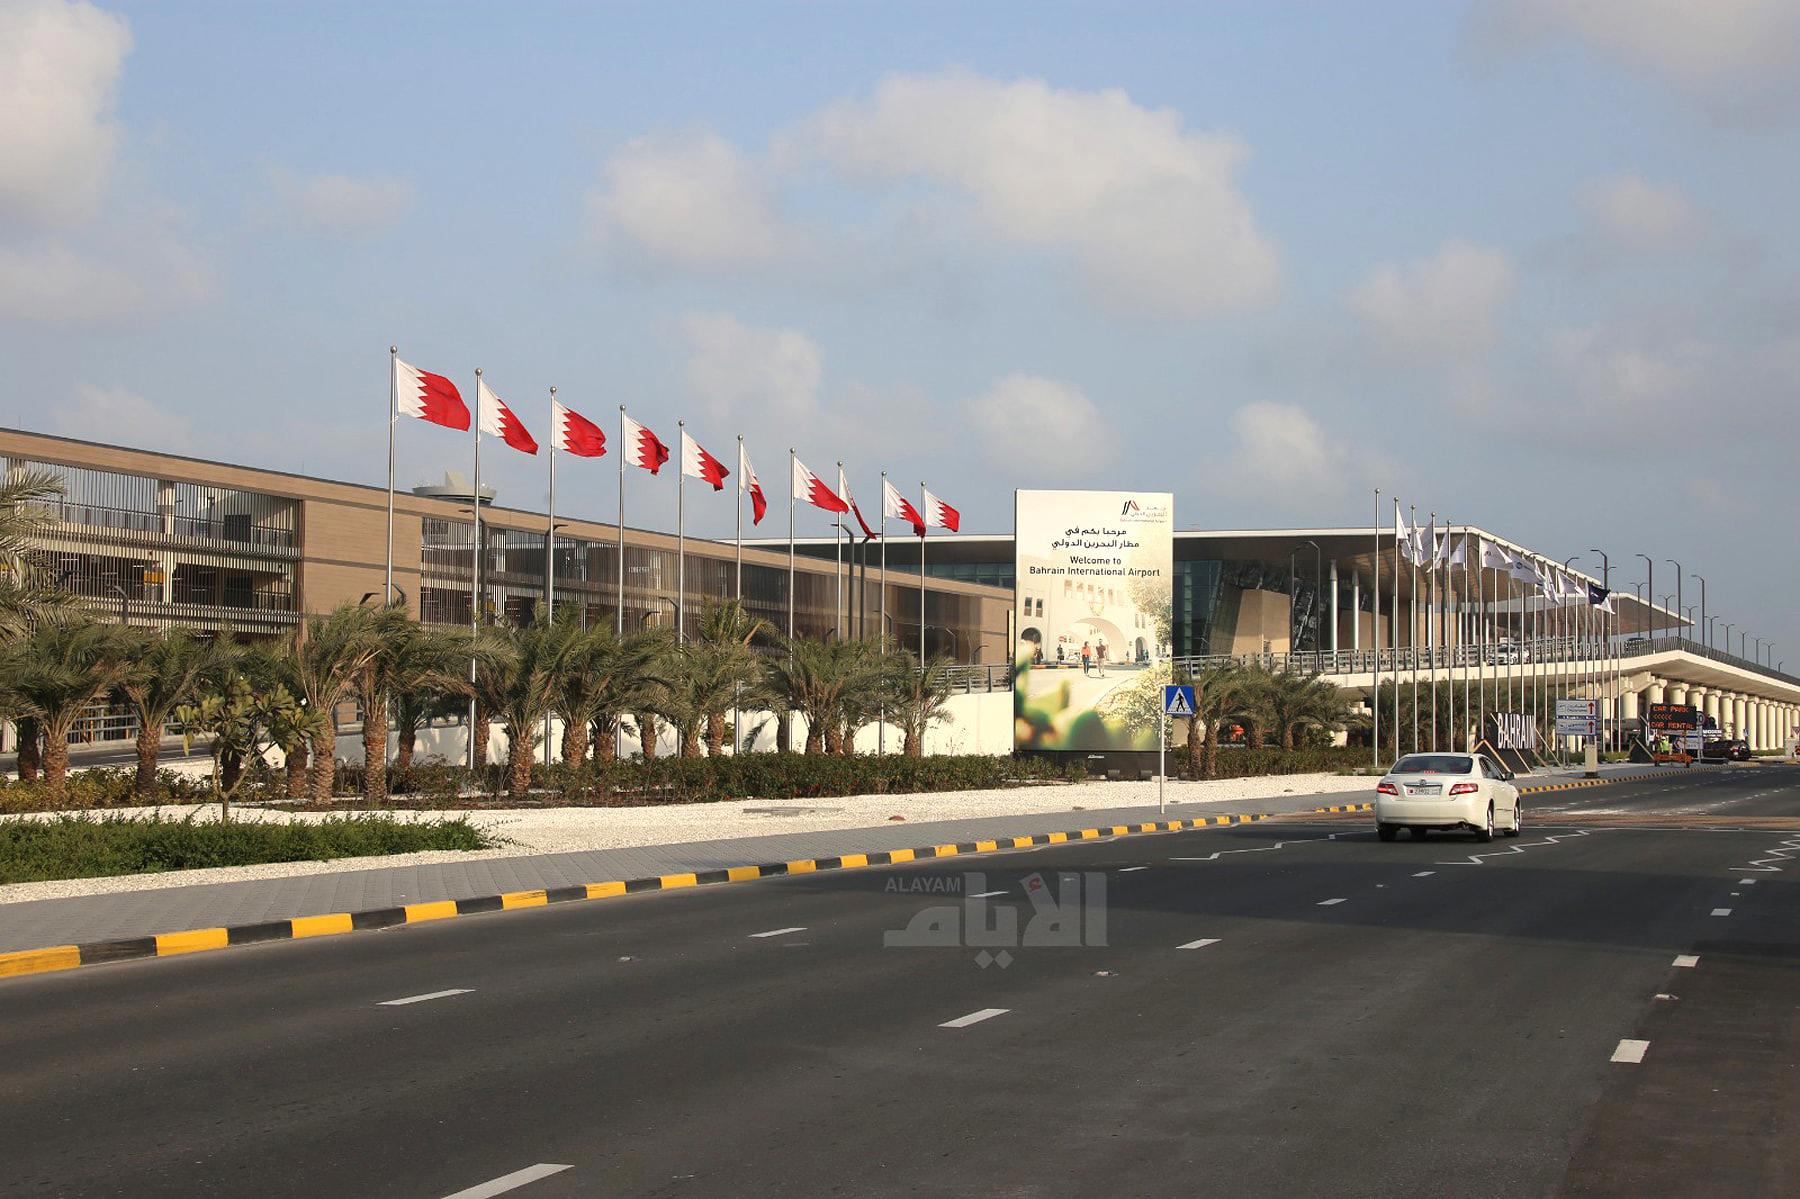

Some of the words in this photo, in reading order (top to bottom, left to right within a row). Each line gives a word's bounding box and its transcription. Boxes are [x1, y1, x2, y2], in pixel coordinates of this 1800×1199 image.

[1065, 526, 1080, 538] في
[1081, 528, 1100, 536] بكم
[1102, 527, 1127, 536] مرحبا
[1051, 539, 1083, 551] الدولي
[1084, 539, 1117, 549] البحرين
[1119, 539, 1140, 549] مطار
[1070, 556, 1111, 565] Welcome
[1113, 557, 1122, 566] to
[1029, 566, 1065, 575] Bahrain
[1067, 567, 1126, 576] International
[1128, 567, 1160, 578] Airport
[1497, 712, 1536, 749] BAHRAIN
